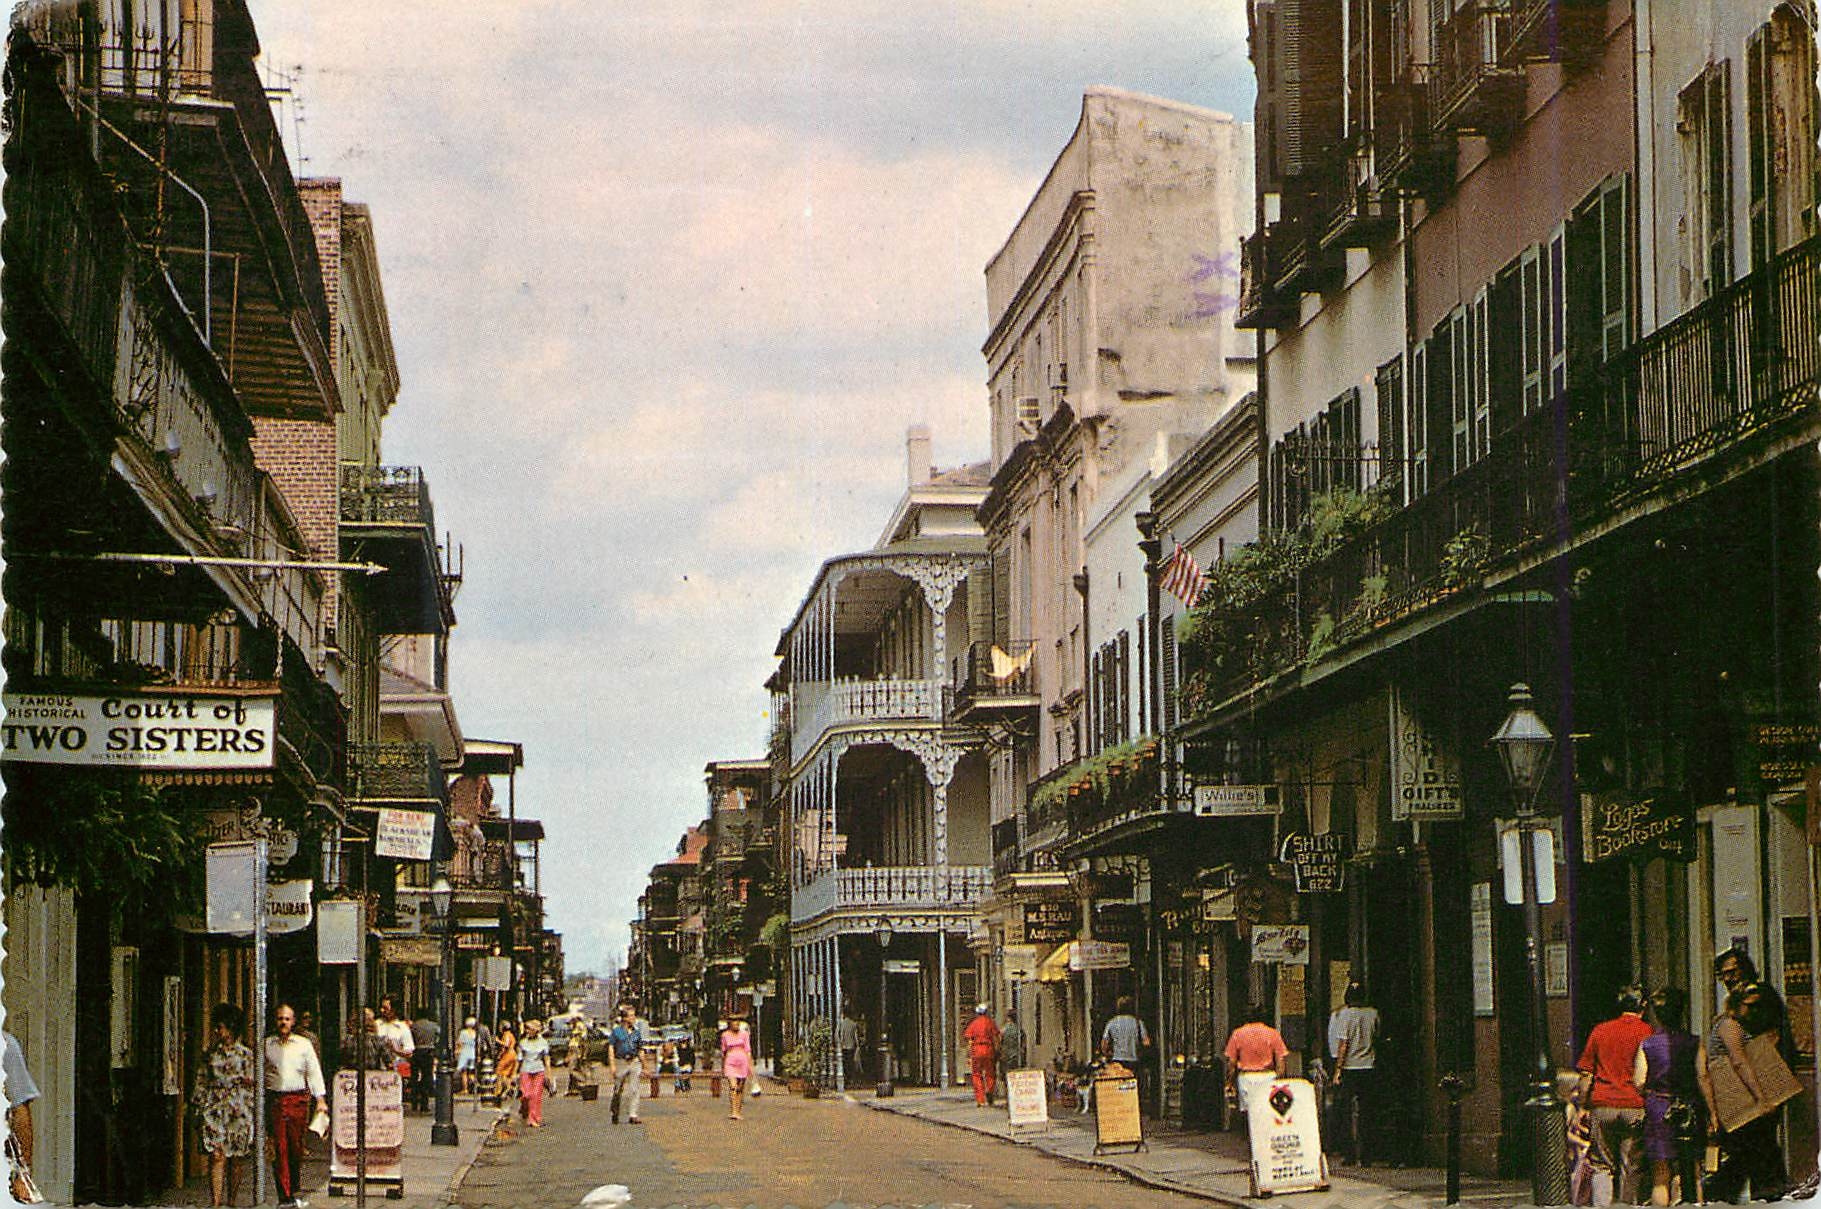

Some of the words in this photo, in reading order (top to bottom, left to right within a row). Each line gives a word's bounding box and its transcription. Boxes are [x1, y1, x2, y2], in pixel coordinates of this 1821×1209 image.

[20, 697, 73, 707] FAMOUS
[8, 708, 86, 719] HISTORICAL
[101, 698, 198, 719] Court
[213, 699, 246, 725] of
[2, 724, 88, 751] TWO
[106, 727, 266, 753] SISTERS
[1293, 835, 1344, 853] SHIRT
[1596, 815, 1685, 858] Bookstore
[1303, 865, 1337, 878] BACK
